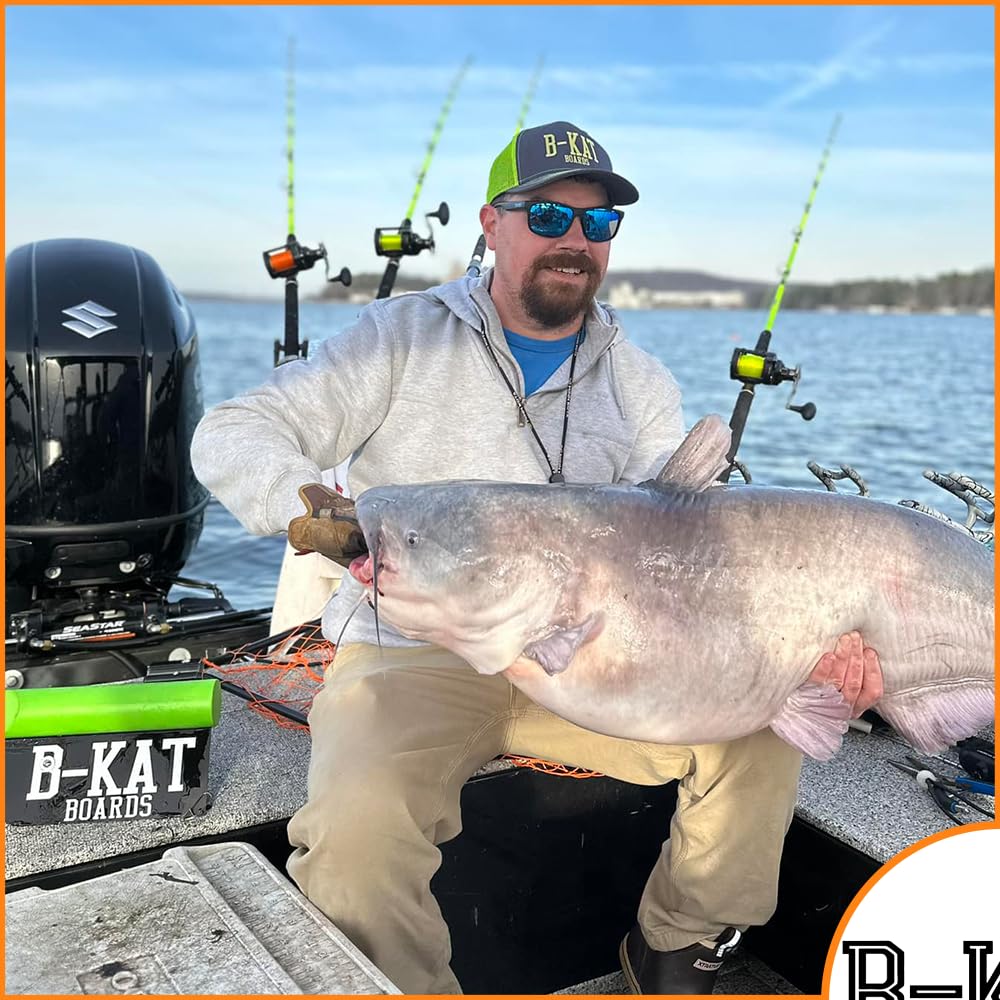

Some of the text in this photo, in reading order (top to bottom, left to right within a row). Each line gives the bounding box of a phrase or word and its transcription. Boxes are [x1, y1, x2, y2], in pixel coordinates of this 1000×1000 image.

[543, 131, 599, 163] B-KAT
[564, 154, 590, 166] BOARDS
[62, 620, 126, 634] SEASTAR
[26, 737, 197, 801] B-KAT
[63, 794, 154, 822] BOARDS
